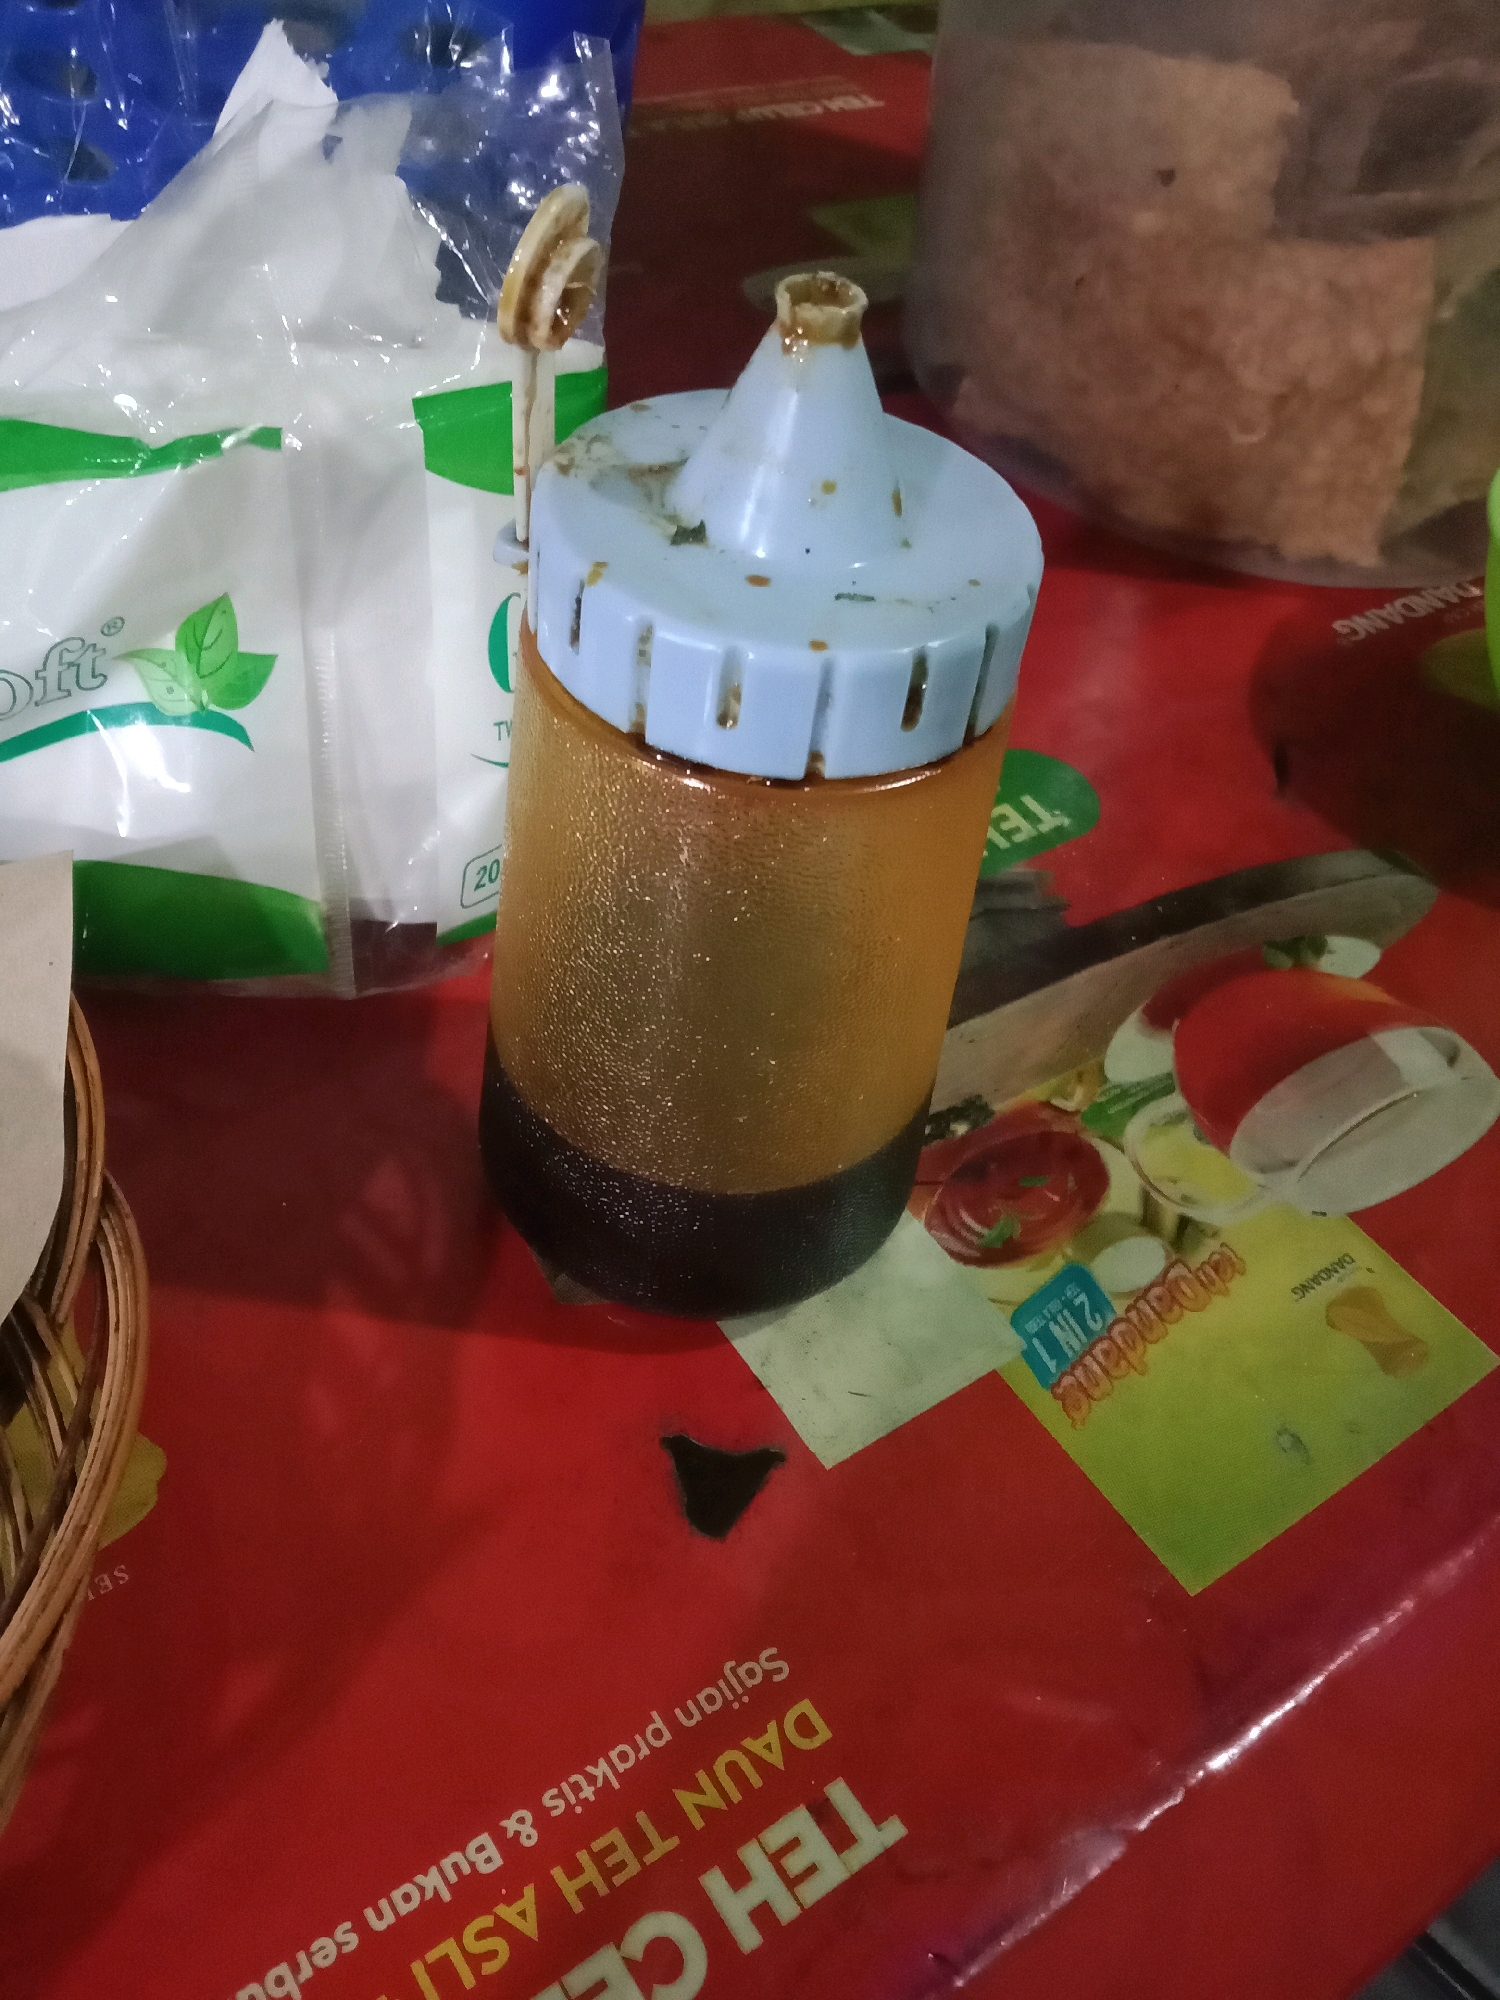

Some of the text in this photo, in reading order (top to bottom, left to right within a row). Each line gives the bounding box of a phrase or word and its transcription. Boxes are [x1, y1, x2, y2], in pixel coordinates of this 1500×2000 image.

[1047, 1308, 1089, 1362] IN
[1072, 1291, 1104, 1334] 2
[1031, 1337, 1058, 1375] 1
[673, 1646, 791, 1728] Sajian
[541, 1710, 673, 1817] praktis
[410, 1698, 833, 2000] DAUN TEH ASLI
[499, 1808, 539, 1848] &
[697, 1775, 909, 1956] TEH
[362, 1831, 504, 1932] Bukan
